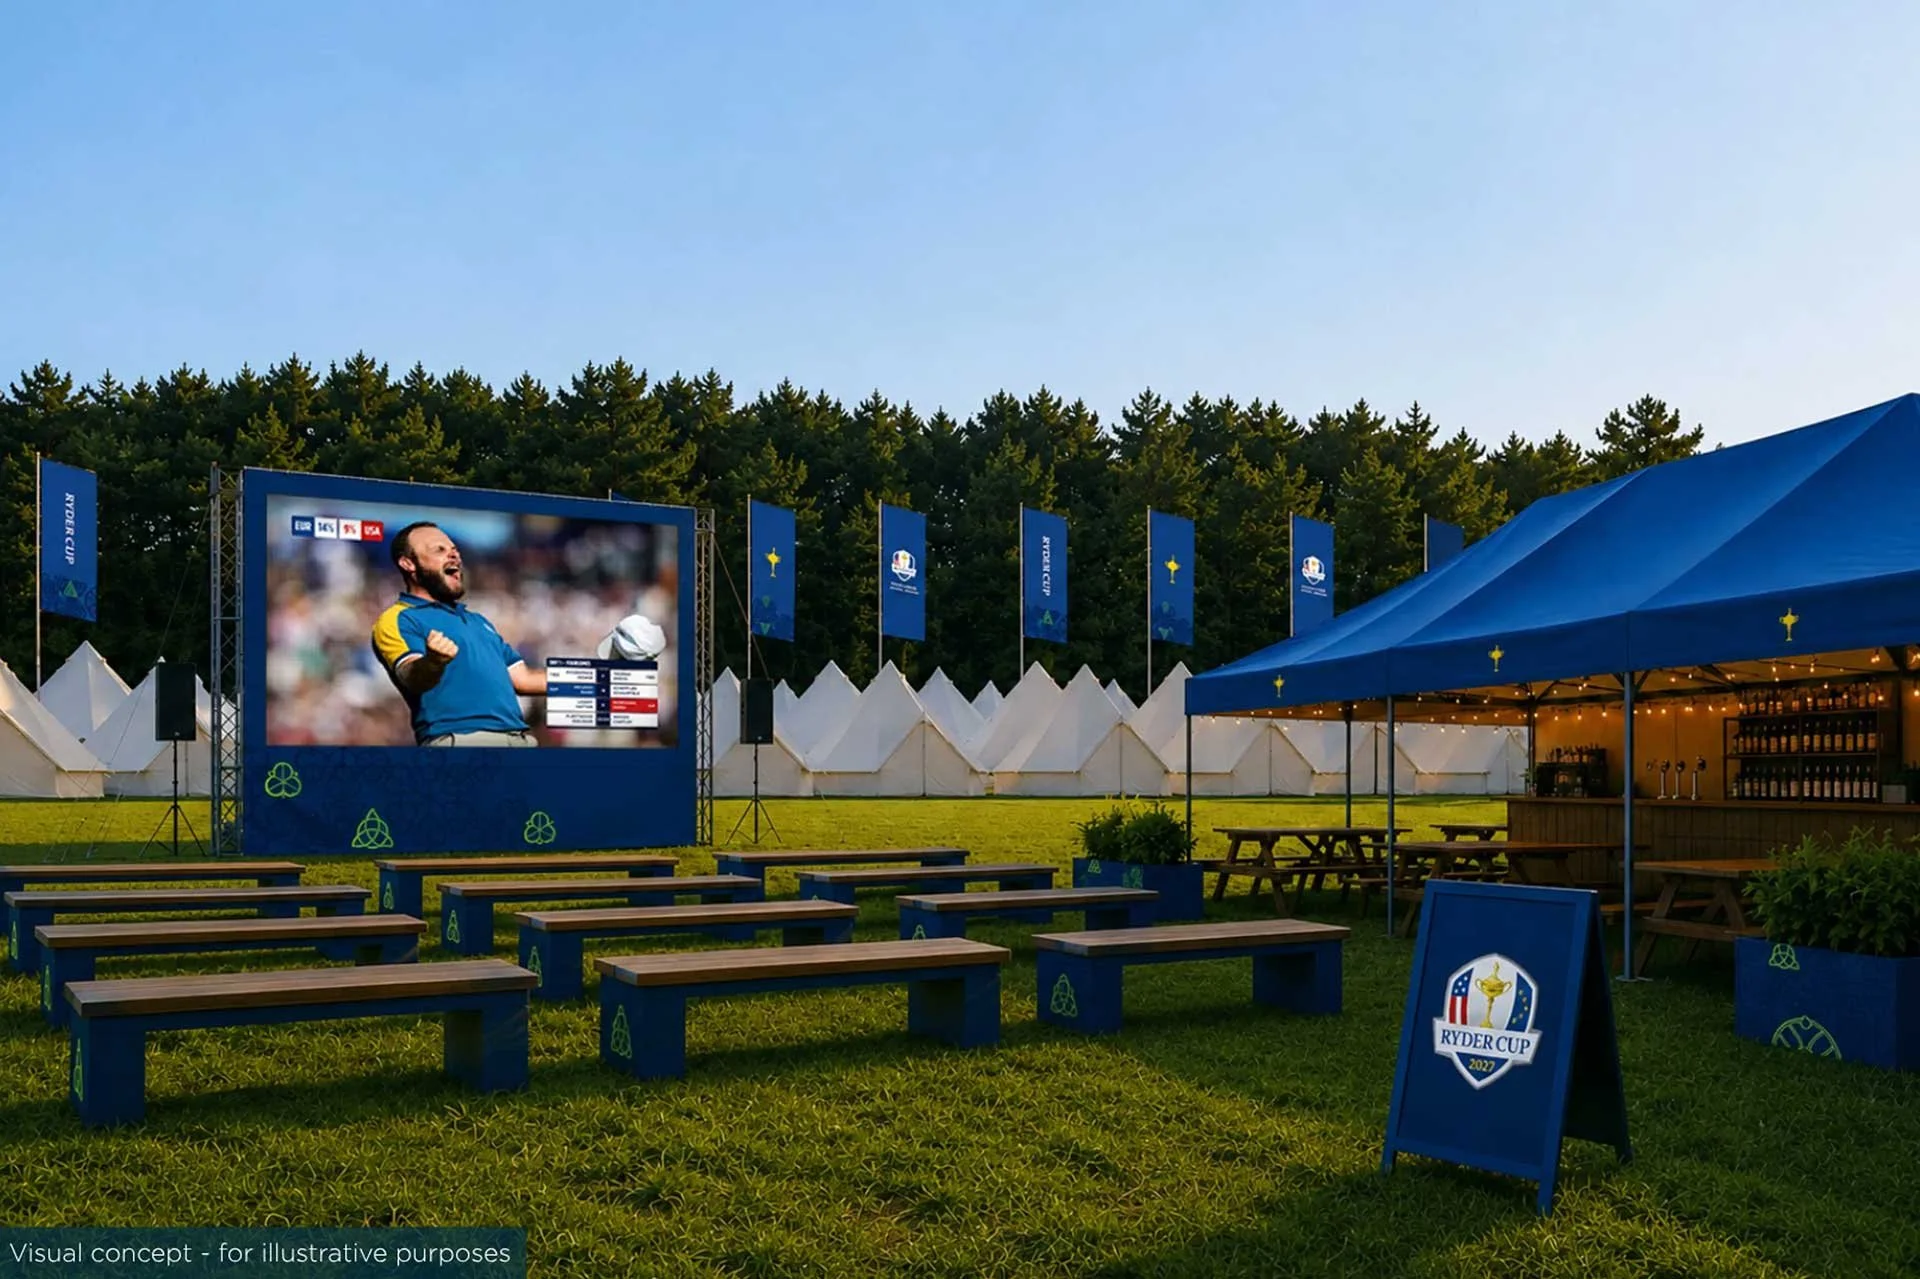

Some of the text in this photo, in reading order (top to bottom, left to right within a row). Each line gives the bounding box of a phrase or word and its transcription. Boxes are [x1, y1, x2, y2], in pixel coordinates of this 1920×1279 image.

[65, 492, 75, 565] RYDER CUP
[295, 521, 312, 531] EUR
[364, 526, 381, 535] USA
[1042, 572, 1050, 596] CUP
[1441, 1029, 1530, 1054] RYDER CUP
[1468, 1058, 1495, 1072] 2027
